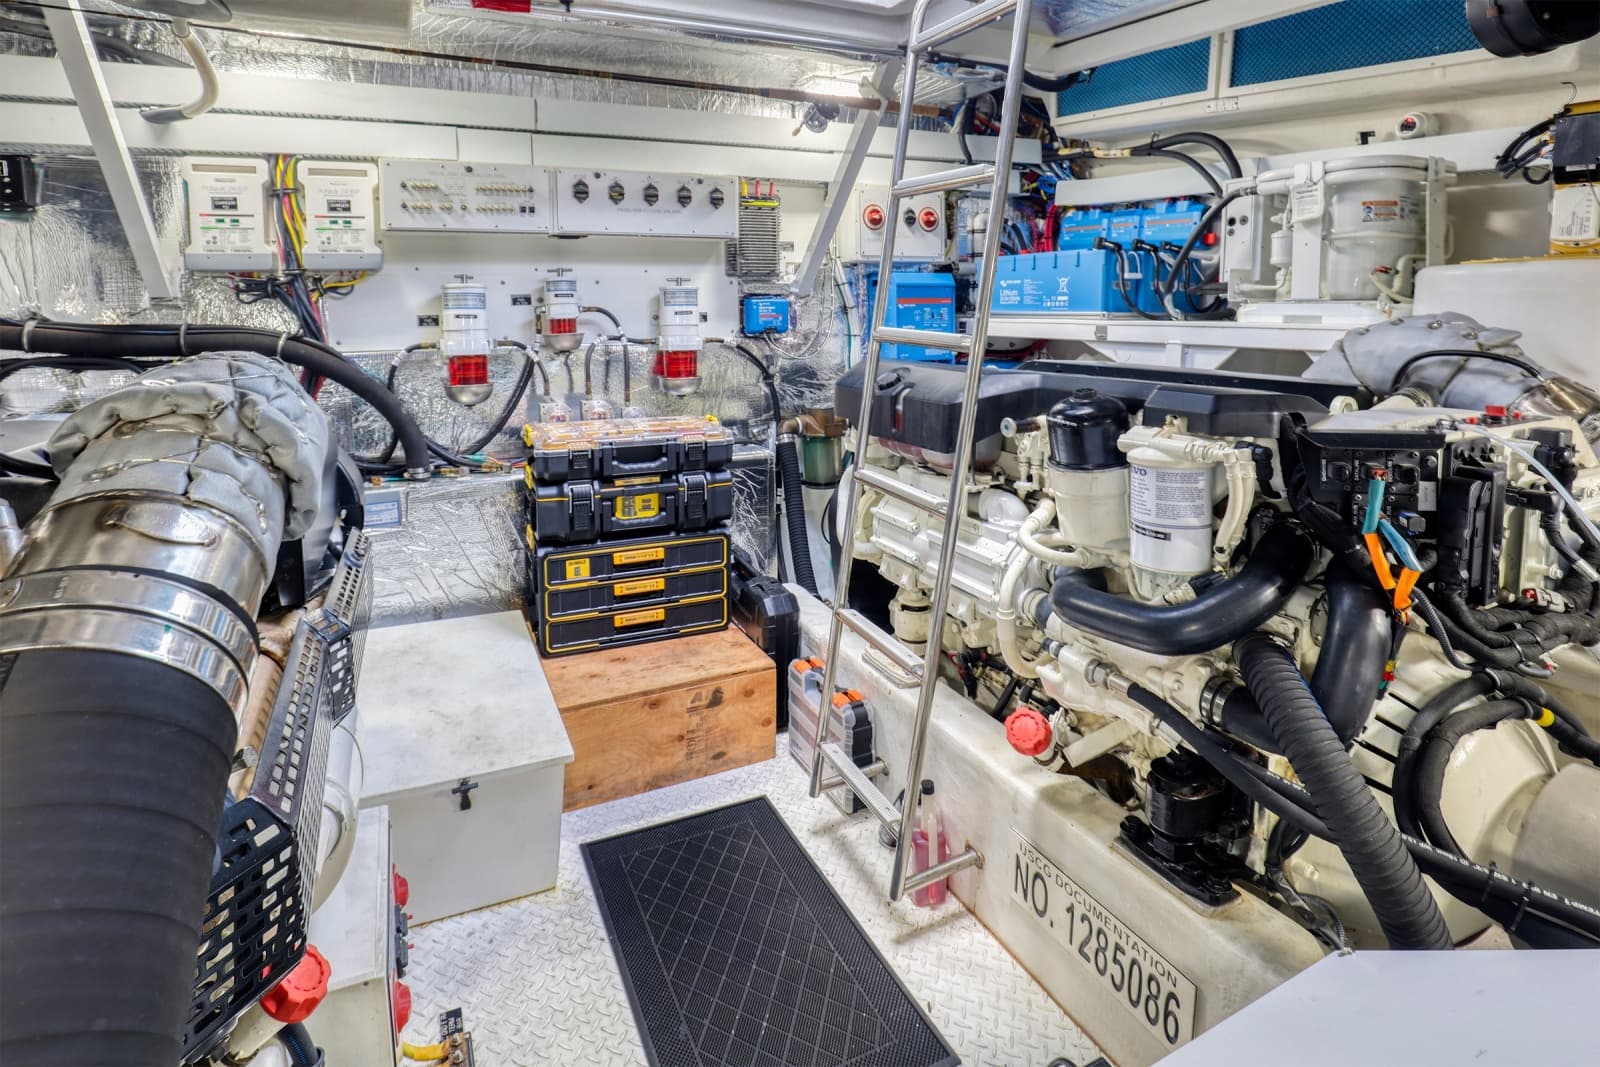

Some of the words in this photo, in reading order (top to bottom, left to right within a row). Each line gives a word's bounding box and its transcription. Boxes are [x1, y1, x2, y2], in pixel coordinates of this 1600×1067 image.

[1014, 853, 1054, 928] NO.
[1066, 902, 1181, 1045] 1285086
[1019, 843, 1052, 878] USCG
[1055, 876, 1177, 988] DOCUMENTATION
